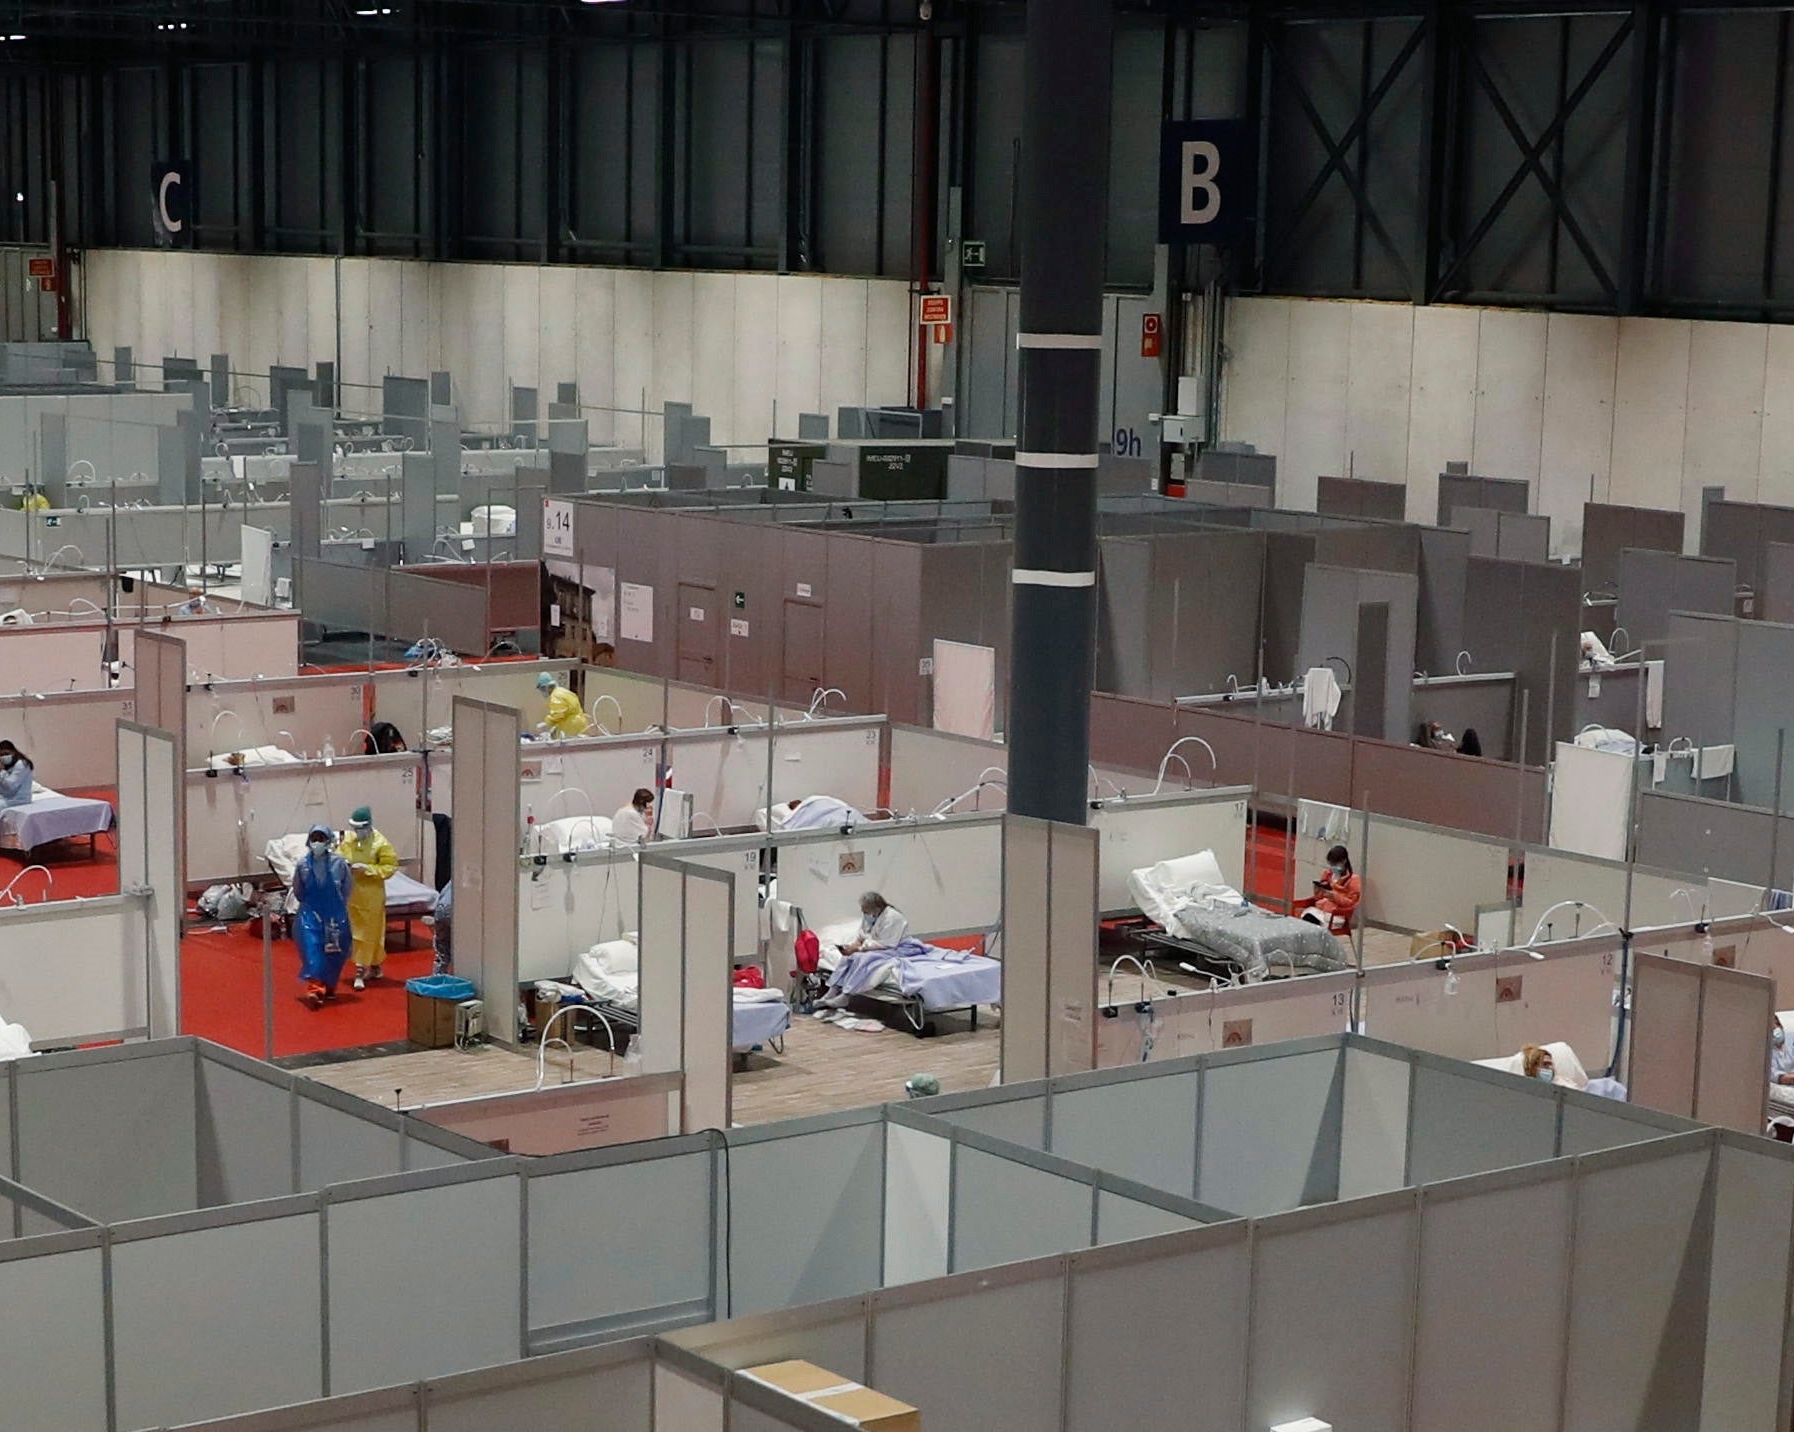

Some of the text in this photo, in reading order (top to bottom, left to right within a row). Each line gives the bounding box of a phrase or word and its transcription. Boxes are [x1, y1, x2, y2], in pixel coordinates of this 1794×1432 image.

[1181, 140, 1222, 225] B
[159, 171, 182, 232] C
[1116, 428, 1141, 457] 9h
[546, 511, 570, 531] 9.14
[1332, 994, 1344, 1006] 13
